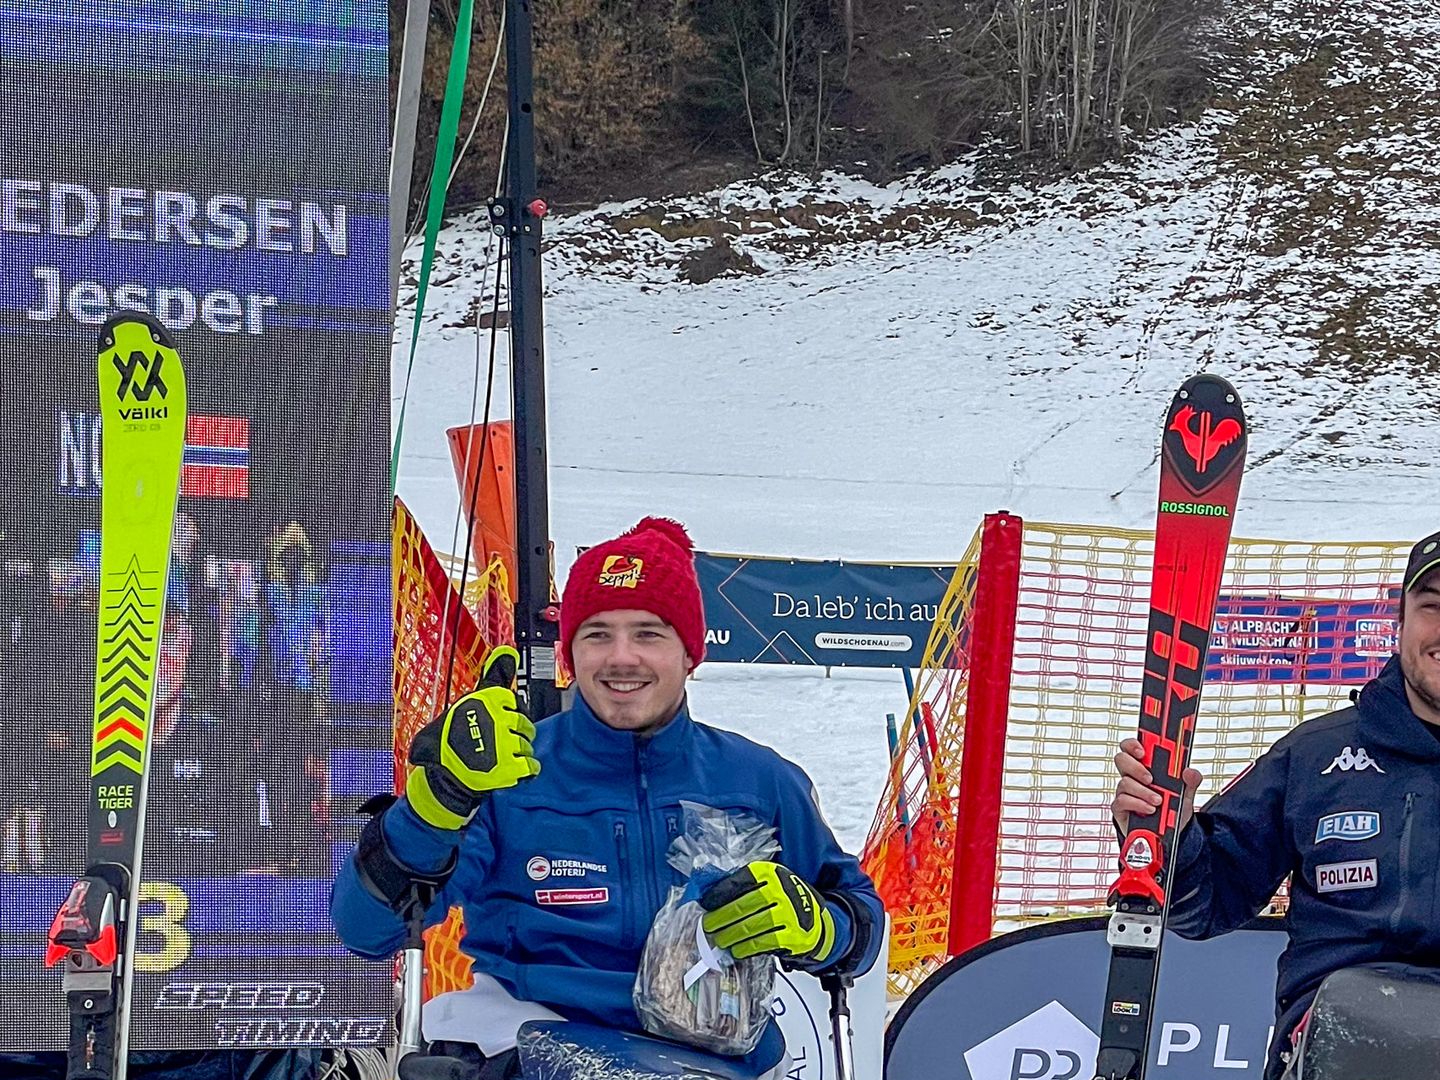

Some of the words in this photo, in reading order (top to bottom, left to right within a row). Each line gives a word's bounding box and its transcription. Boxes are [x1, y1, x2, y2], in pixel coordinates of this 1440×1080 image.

[0, 178, 348, 256] EDERSEN
[28, 266, 279, 335] Jesper
[1160, 501, 1230, 517] ROSSIGNOL
[772, 592, 811, 618] Da
[865, 597, 905, 621] ich
[466, 709, 485, 753] LEKI
[98, 785, 134, 797] RACE
[98, 798, 133, 809] TIGER
[551, 859, 608, 873] NEDERLANDSE
[551, 868, 586, 877] LOTERIJ
[1319, 865, 1374, 887] POLIZIA
[552, 891, 603, 901] wintersport.nl
[1156, 1021, 1274, 1070] PL
